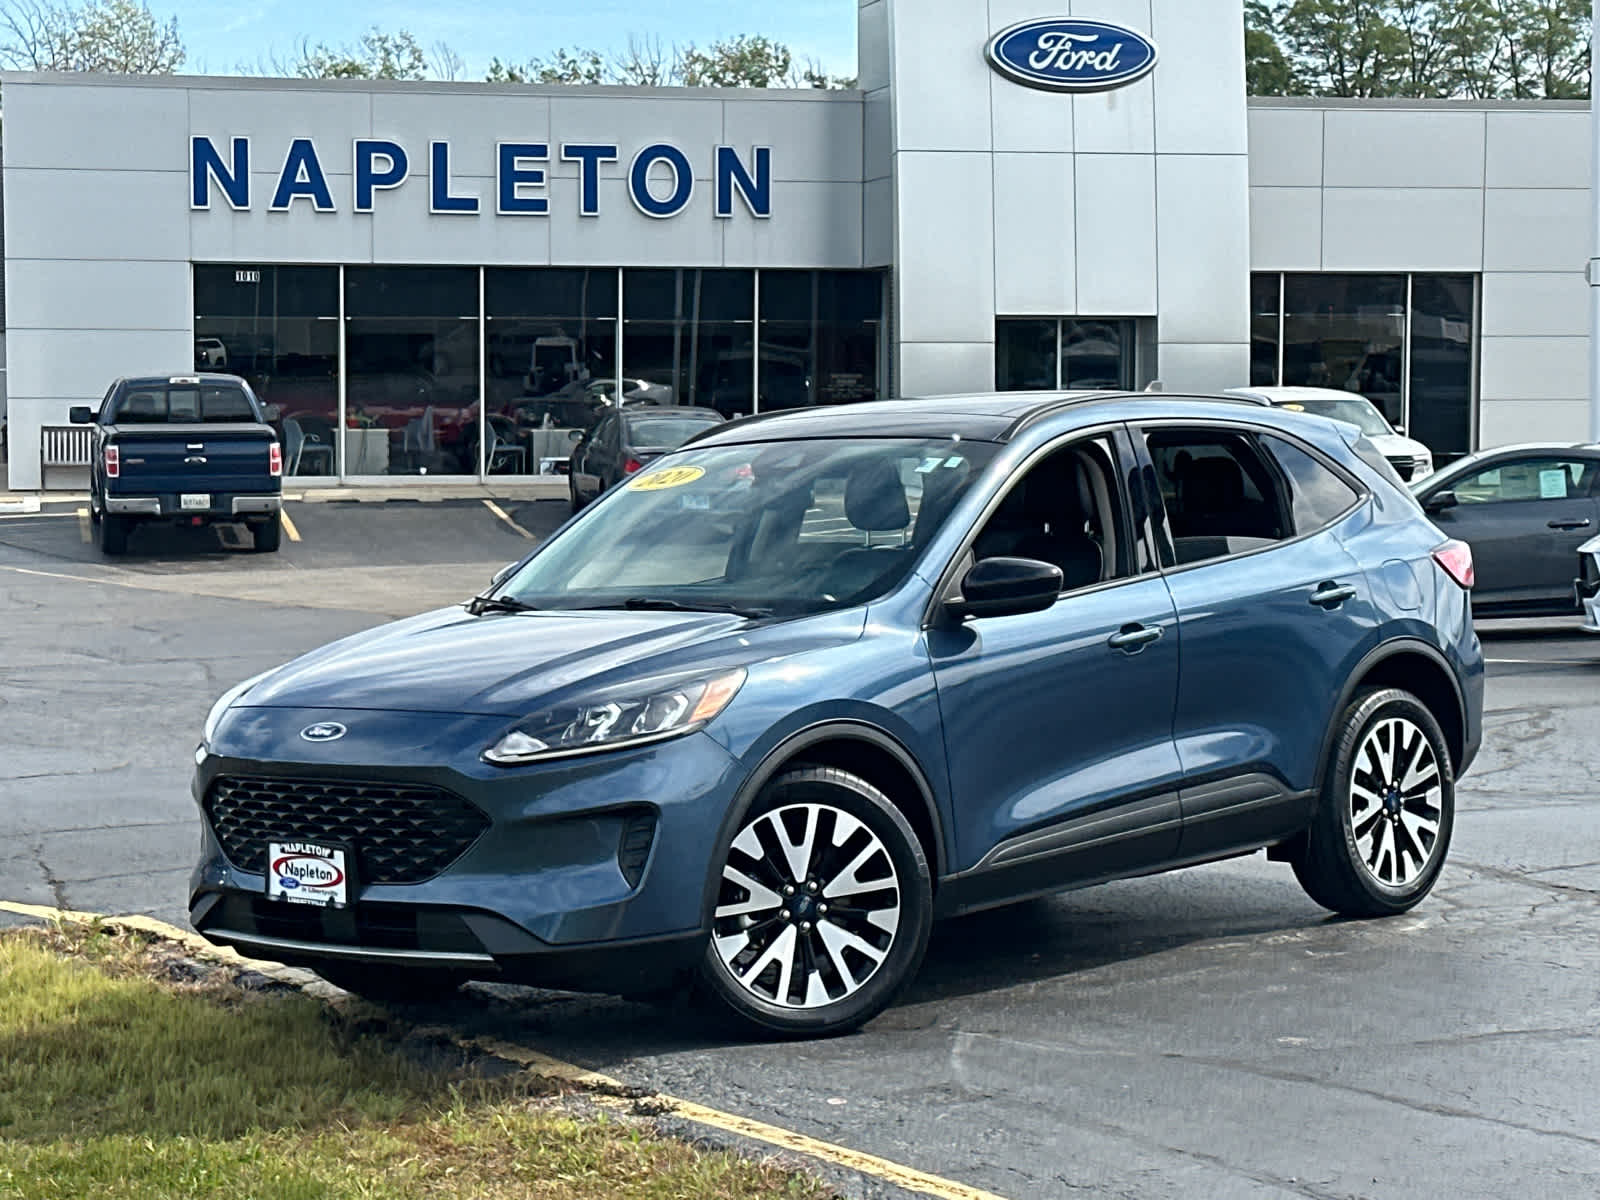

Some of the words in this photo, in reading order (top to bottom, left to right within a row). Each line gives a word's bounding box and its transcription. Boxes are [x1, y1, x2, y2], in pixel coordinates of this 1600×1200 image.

[1028, 31, 1123, 71] Ford
[189, 135, 772, 218] NAPLETON
[236, 270, 260, 282] 1010
[284, 860, 333, 881] Napleton
